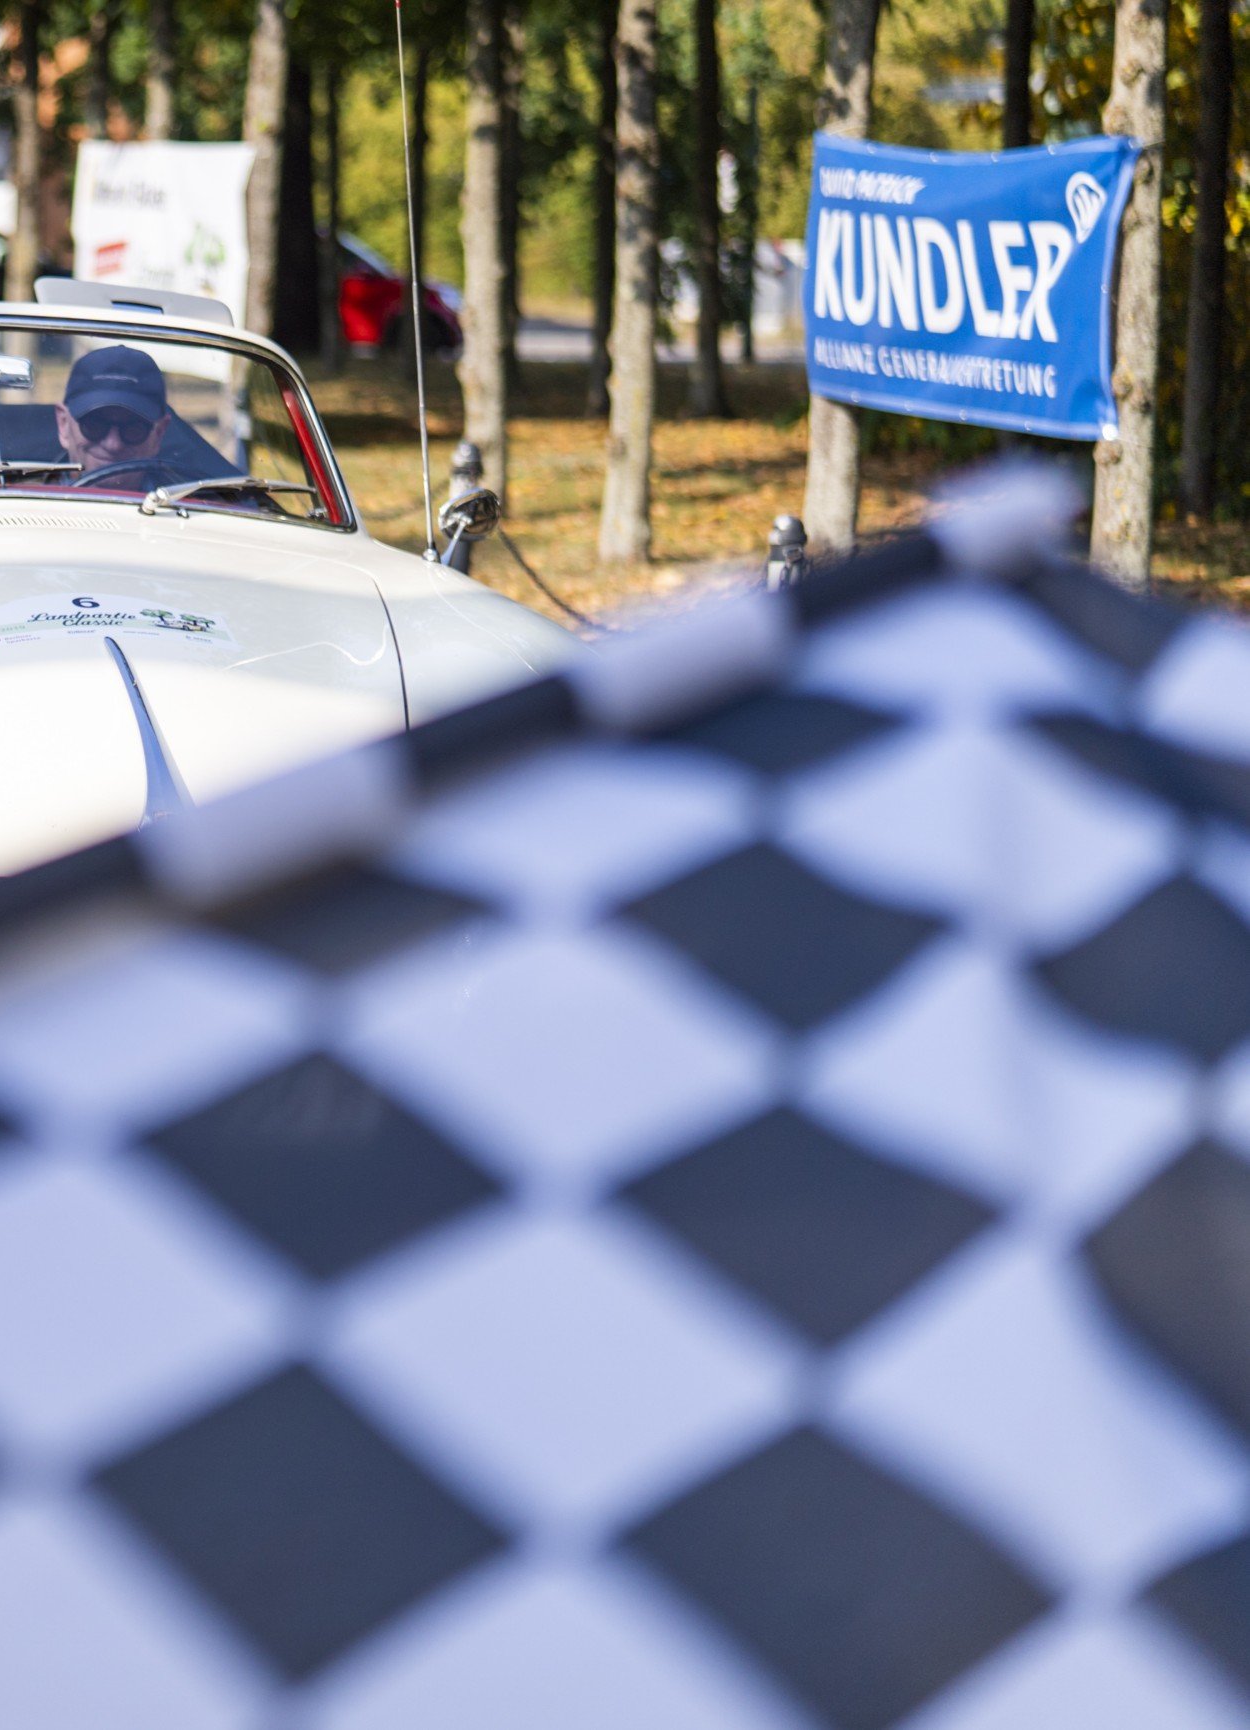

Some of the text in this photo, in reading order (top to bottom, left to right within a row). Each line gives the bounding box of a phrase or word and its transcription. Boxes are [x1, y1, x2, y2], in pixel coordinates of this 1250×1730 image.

[814, 207, 1073, 343] KUNDLER
[71, 597, 100, 608] 6
[27, 611, 136, 623] Landpartie
[62, 618, 123, 627] Classic
